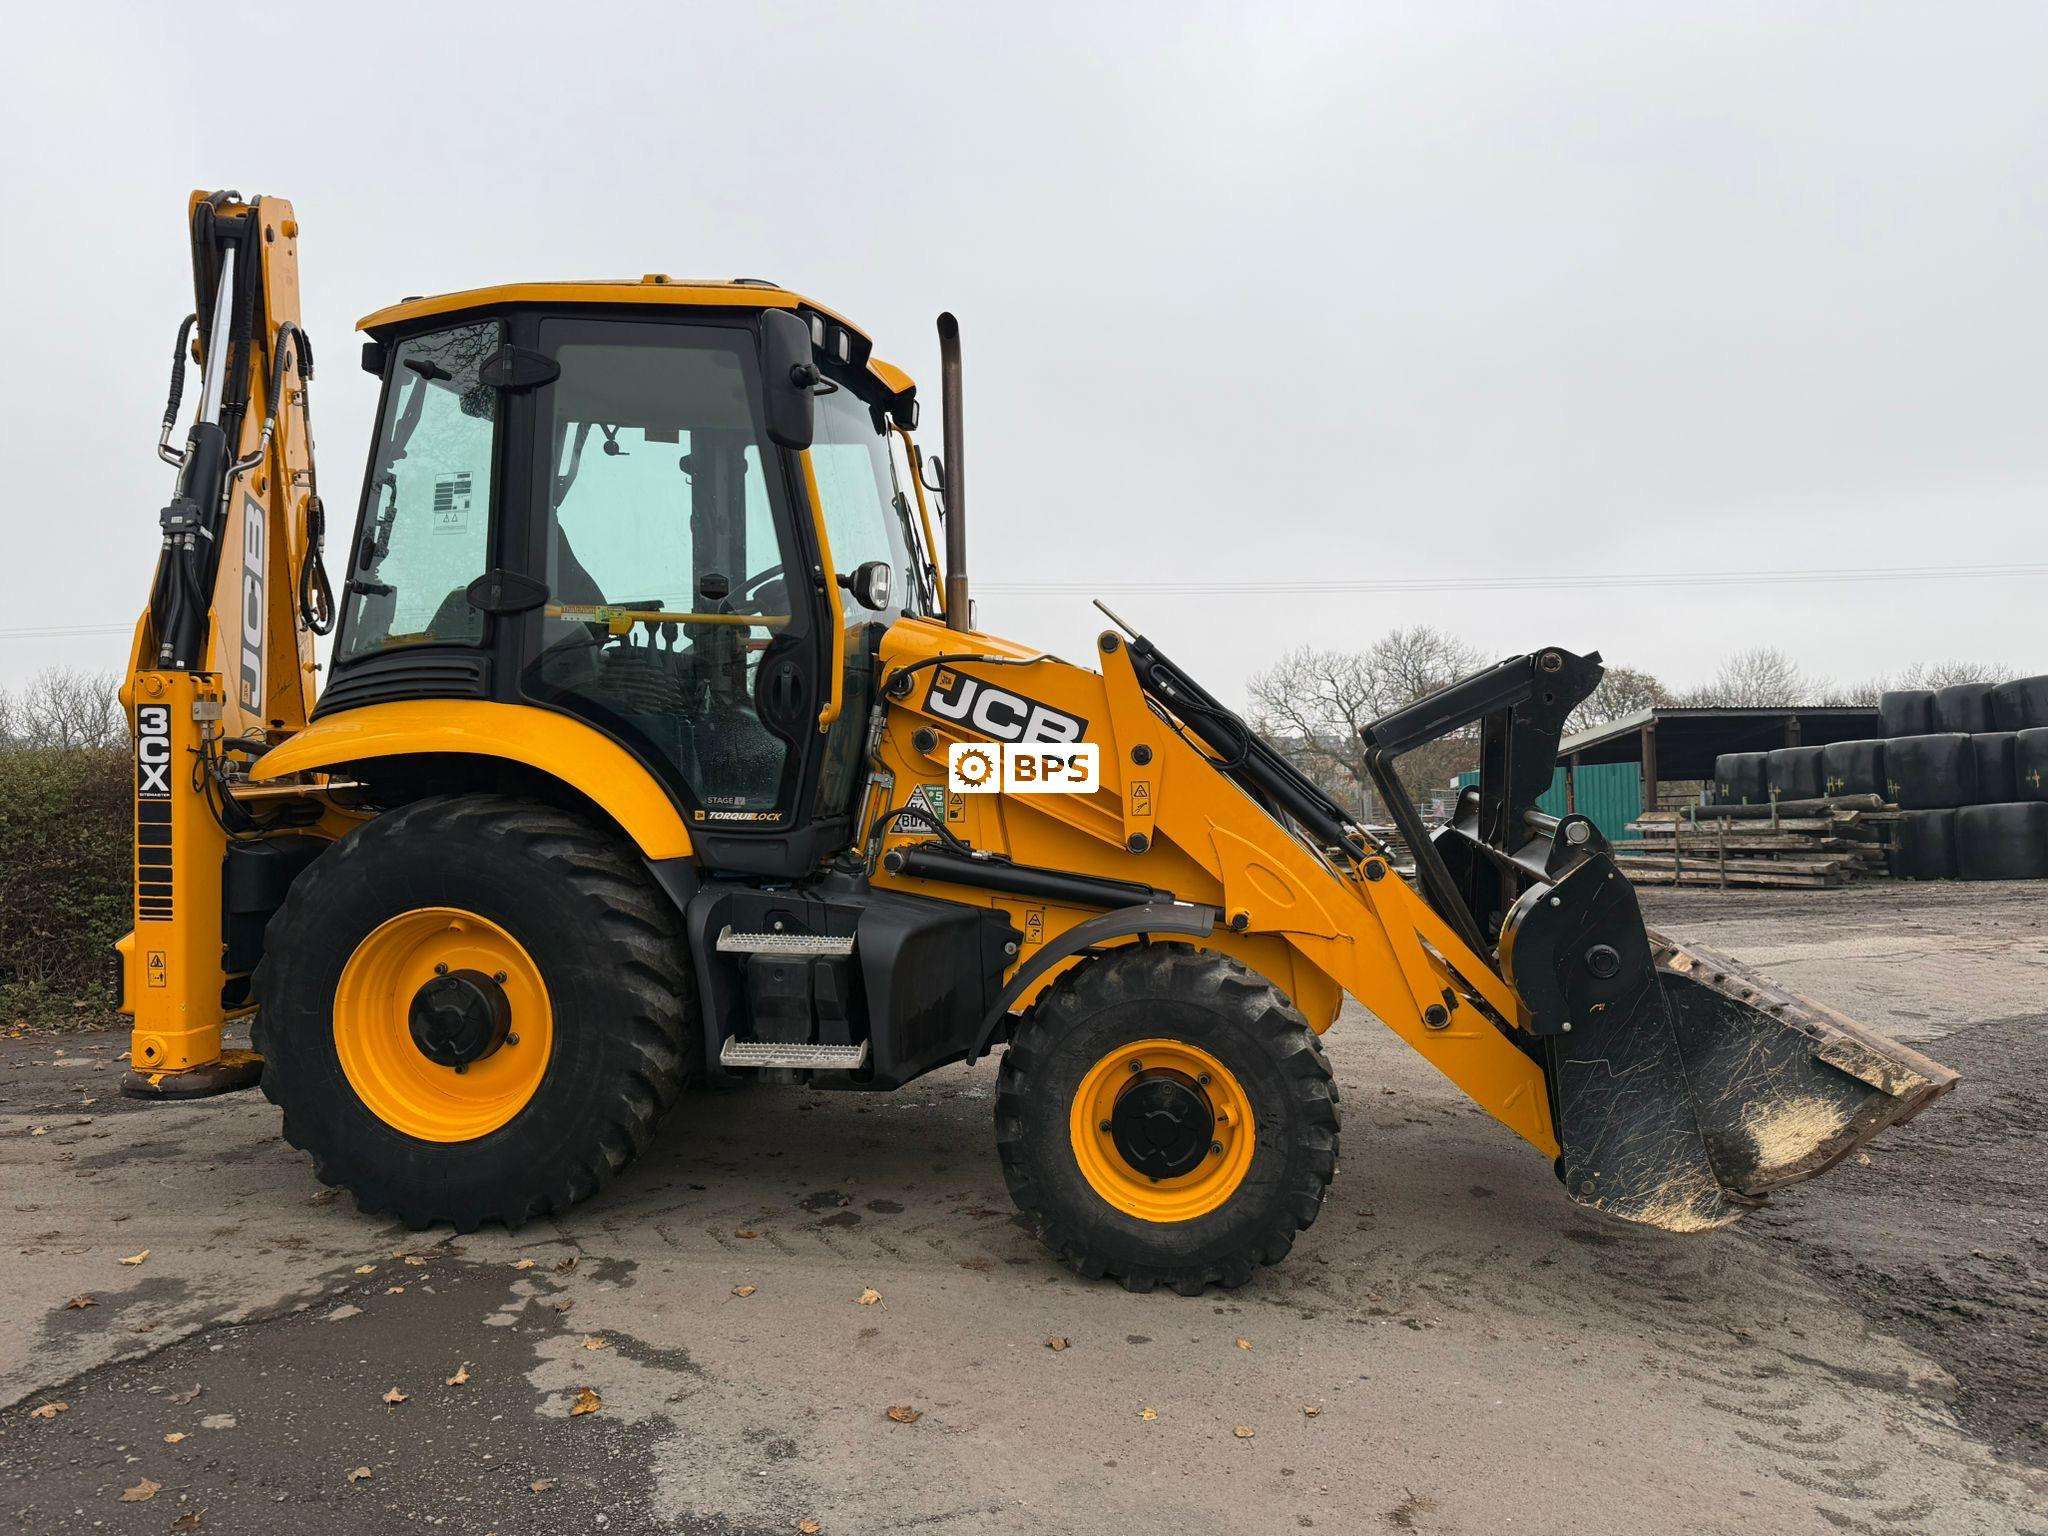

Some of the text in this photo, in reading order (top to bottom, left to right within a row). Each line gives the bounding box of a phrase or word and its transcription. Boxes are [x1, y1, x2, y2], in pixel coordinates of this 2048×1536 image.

[243, 503, 263, 708] JCB
[929, 679, 1080, 743] JCB
[139, 707, 170, 791] 3CX
[708, 811, 782, 821] TORQUELOCK
